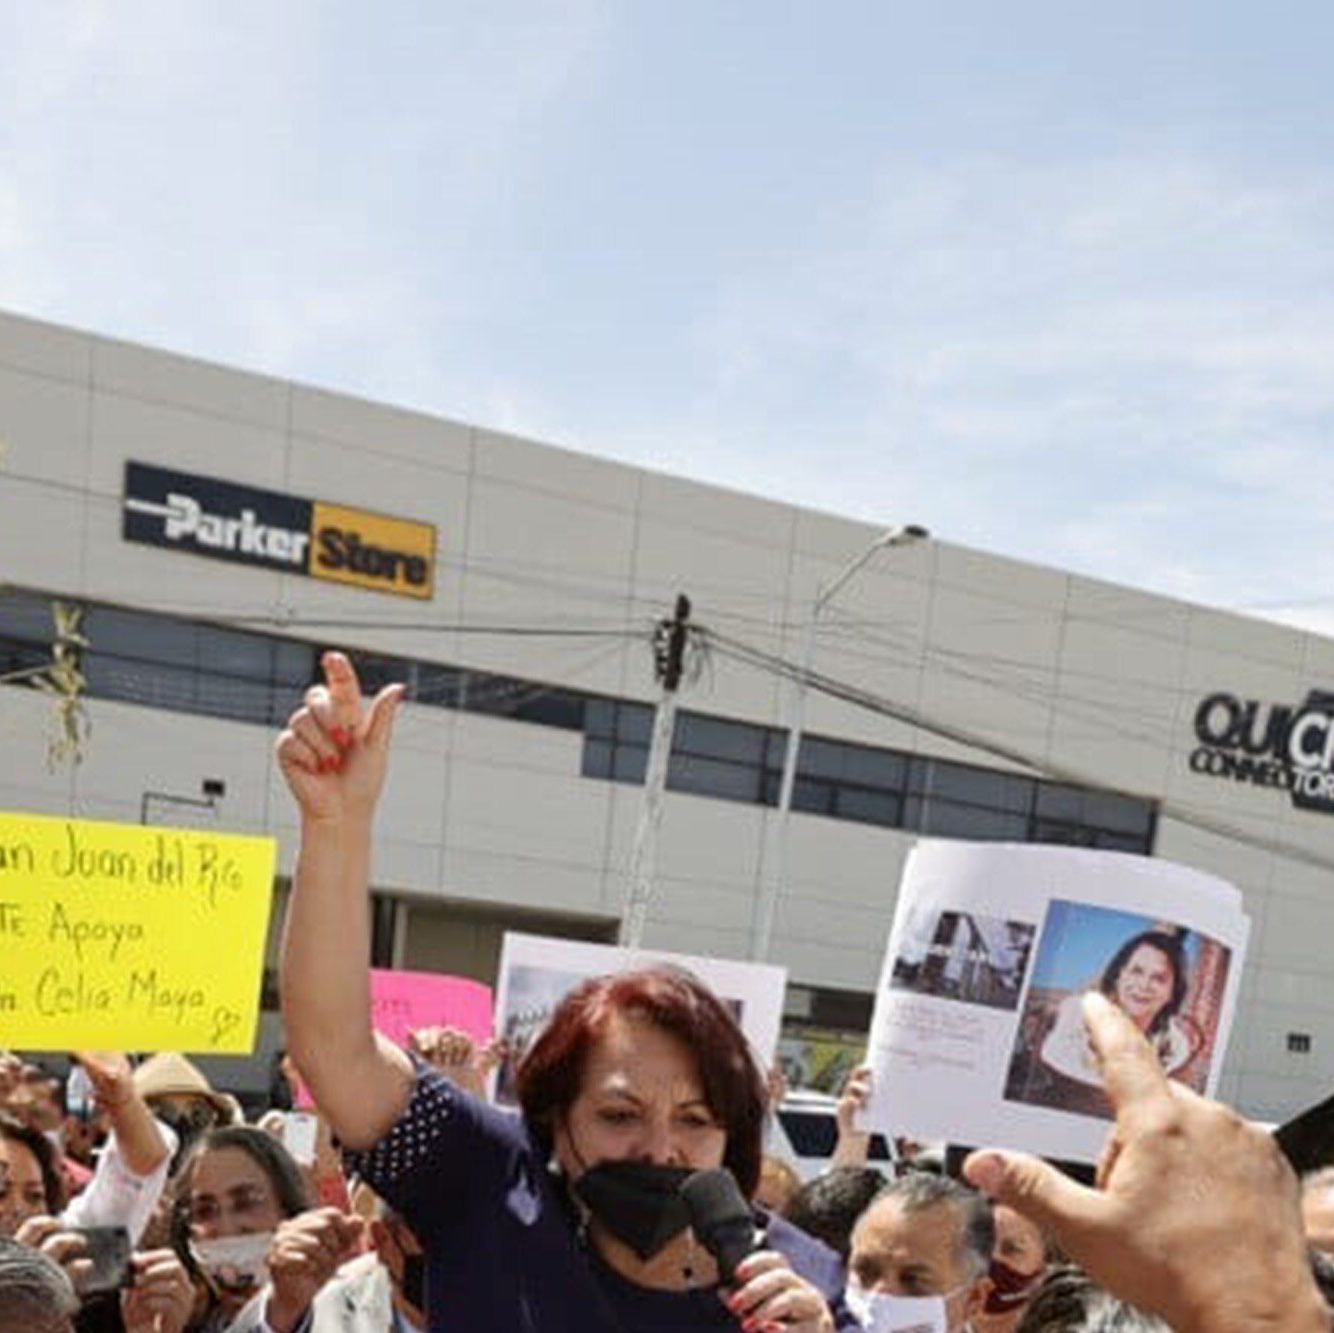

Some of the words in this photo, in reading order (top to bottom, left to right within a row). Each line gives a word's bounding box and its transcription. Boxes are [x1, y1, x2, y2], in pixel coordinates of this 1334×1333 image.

[163, 492, 311, 564] Parker
[317, 527, 428, 585] Store
[52, 823, 136, 881] Juan
[148, 834, 184, 885] del
[48, 902, 144, 962] Apoya
[35, 967, 111, 1017] Celia
[128, 969, 205, 1026] Maya
